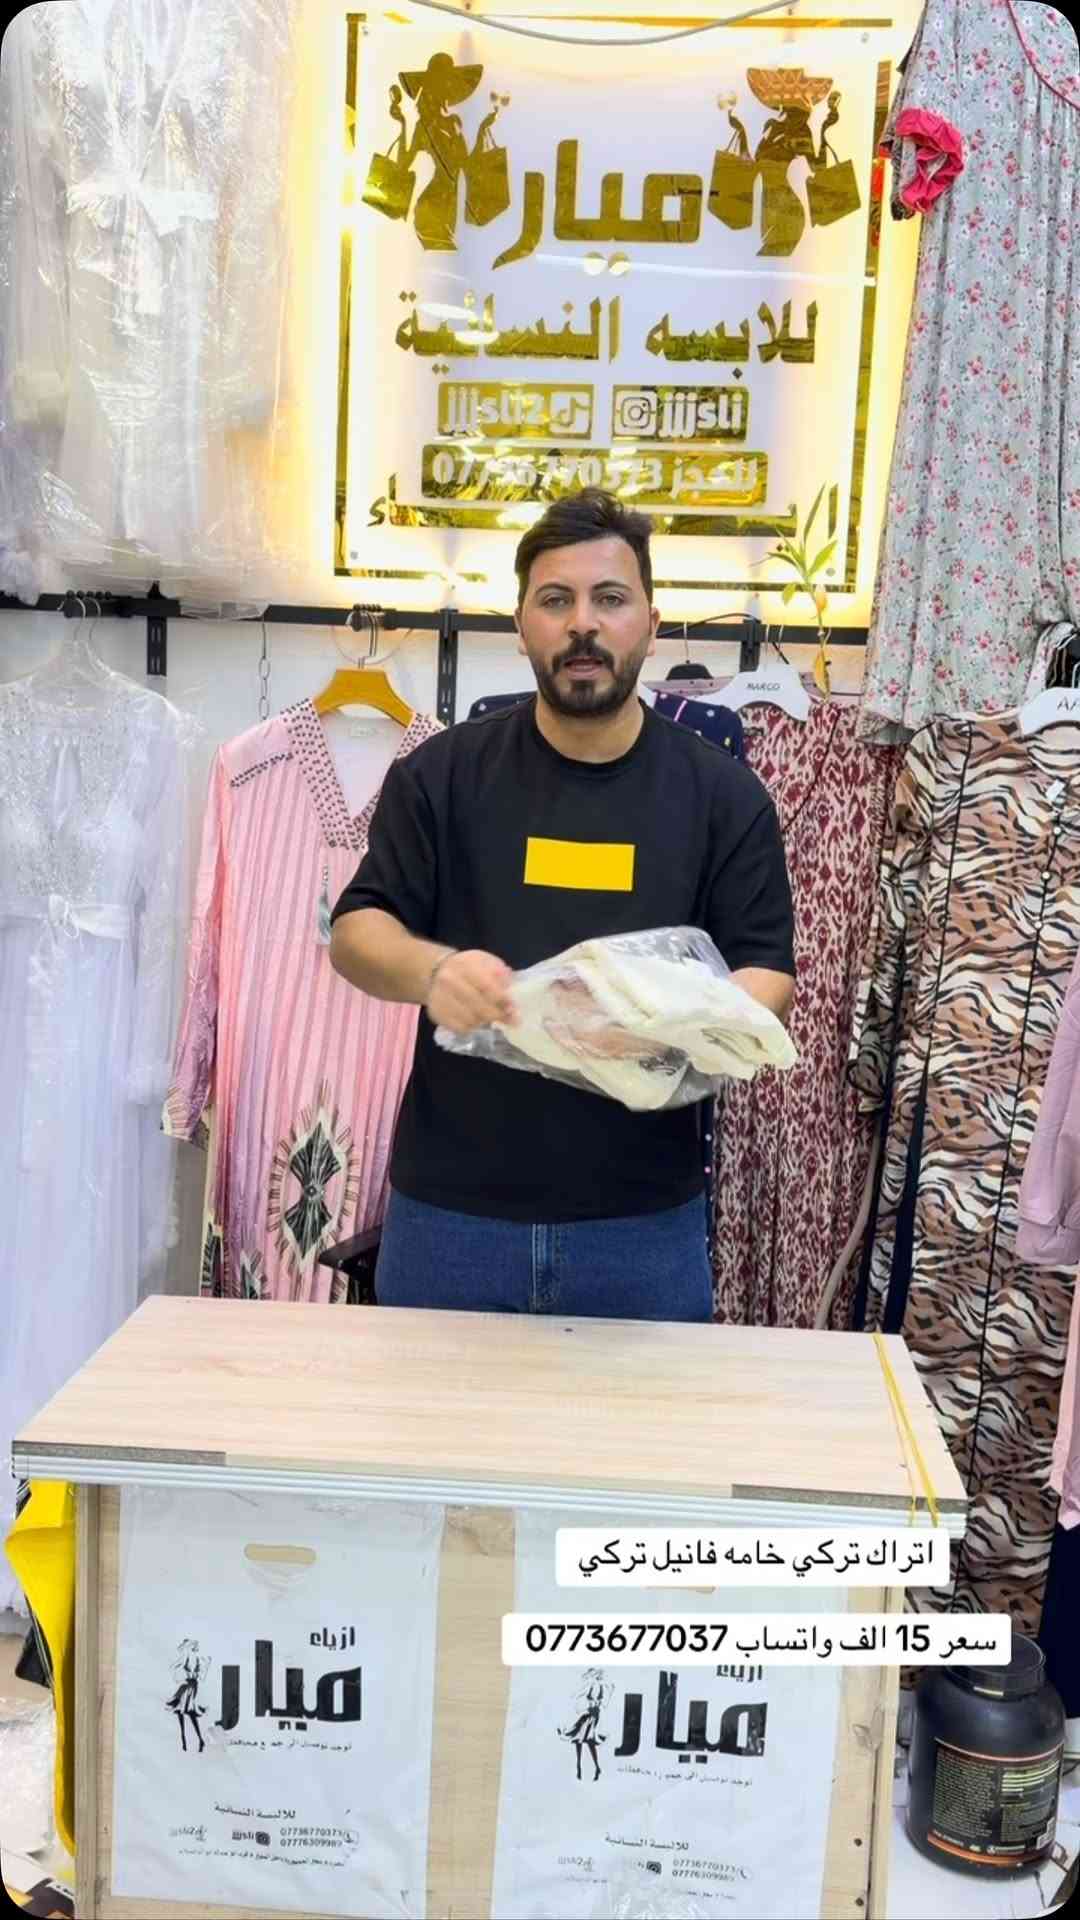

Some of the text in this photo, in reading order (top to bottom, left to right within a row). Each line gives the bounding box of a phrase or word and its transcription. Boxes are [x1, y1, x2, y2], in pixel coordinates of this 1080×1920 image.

[492, 139, 704, 276] ميار
[658, 391, 742, 438] jjjsli
[215, 1639, 361, 1731] ميار
[614, 1670, 768, 1764] ميار
